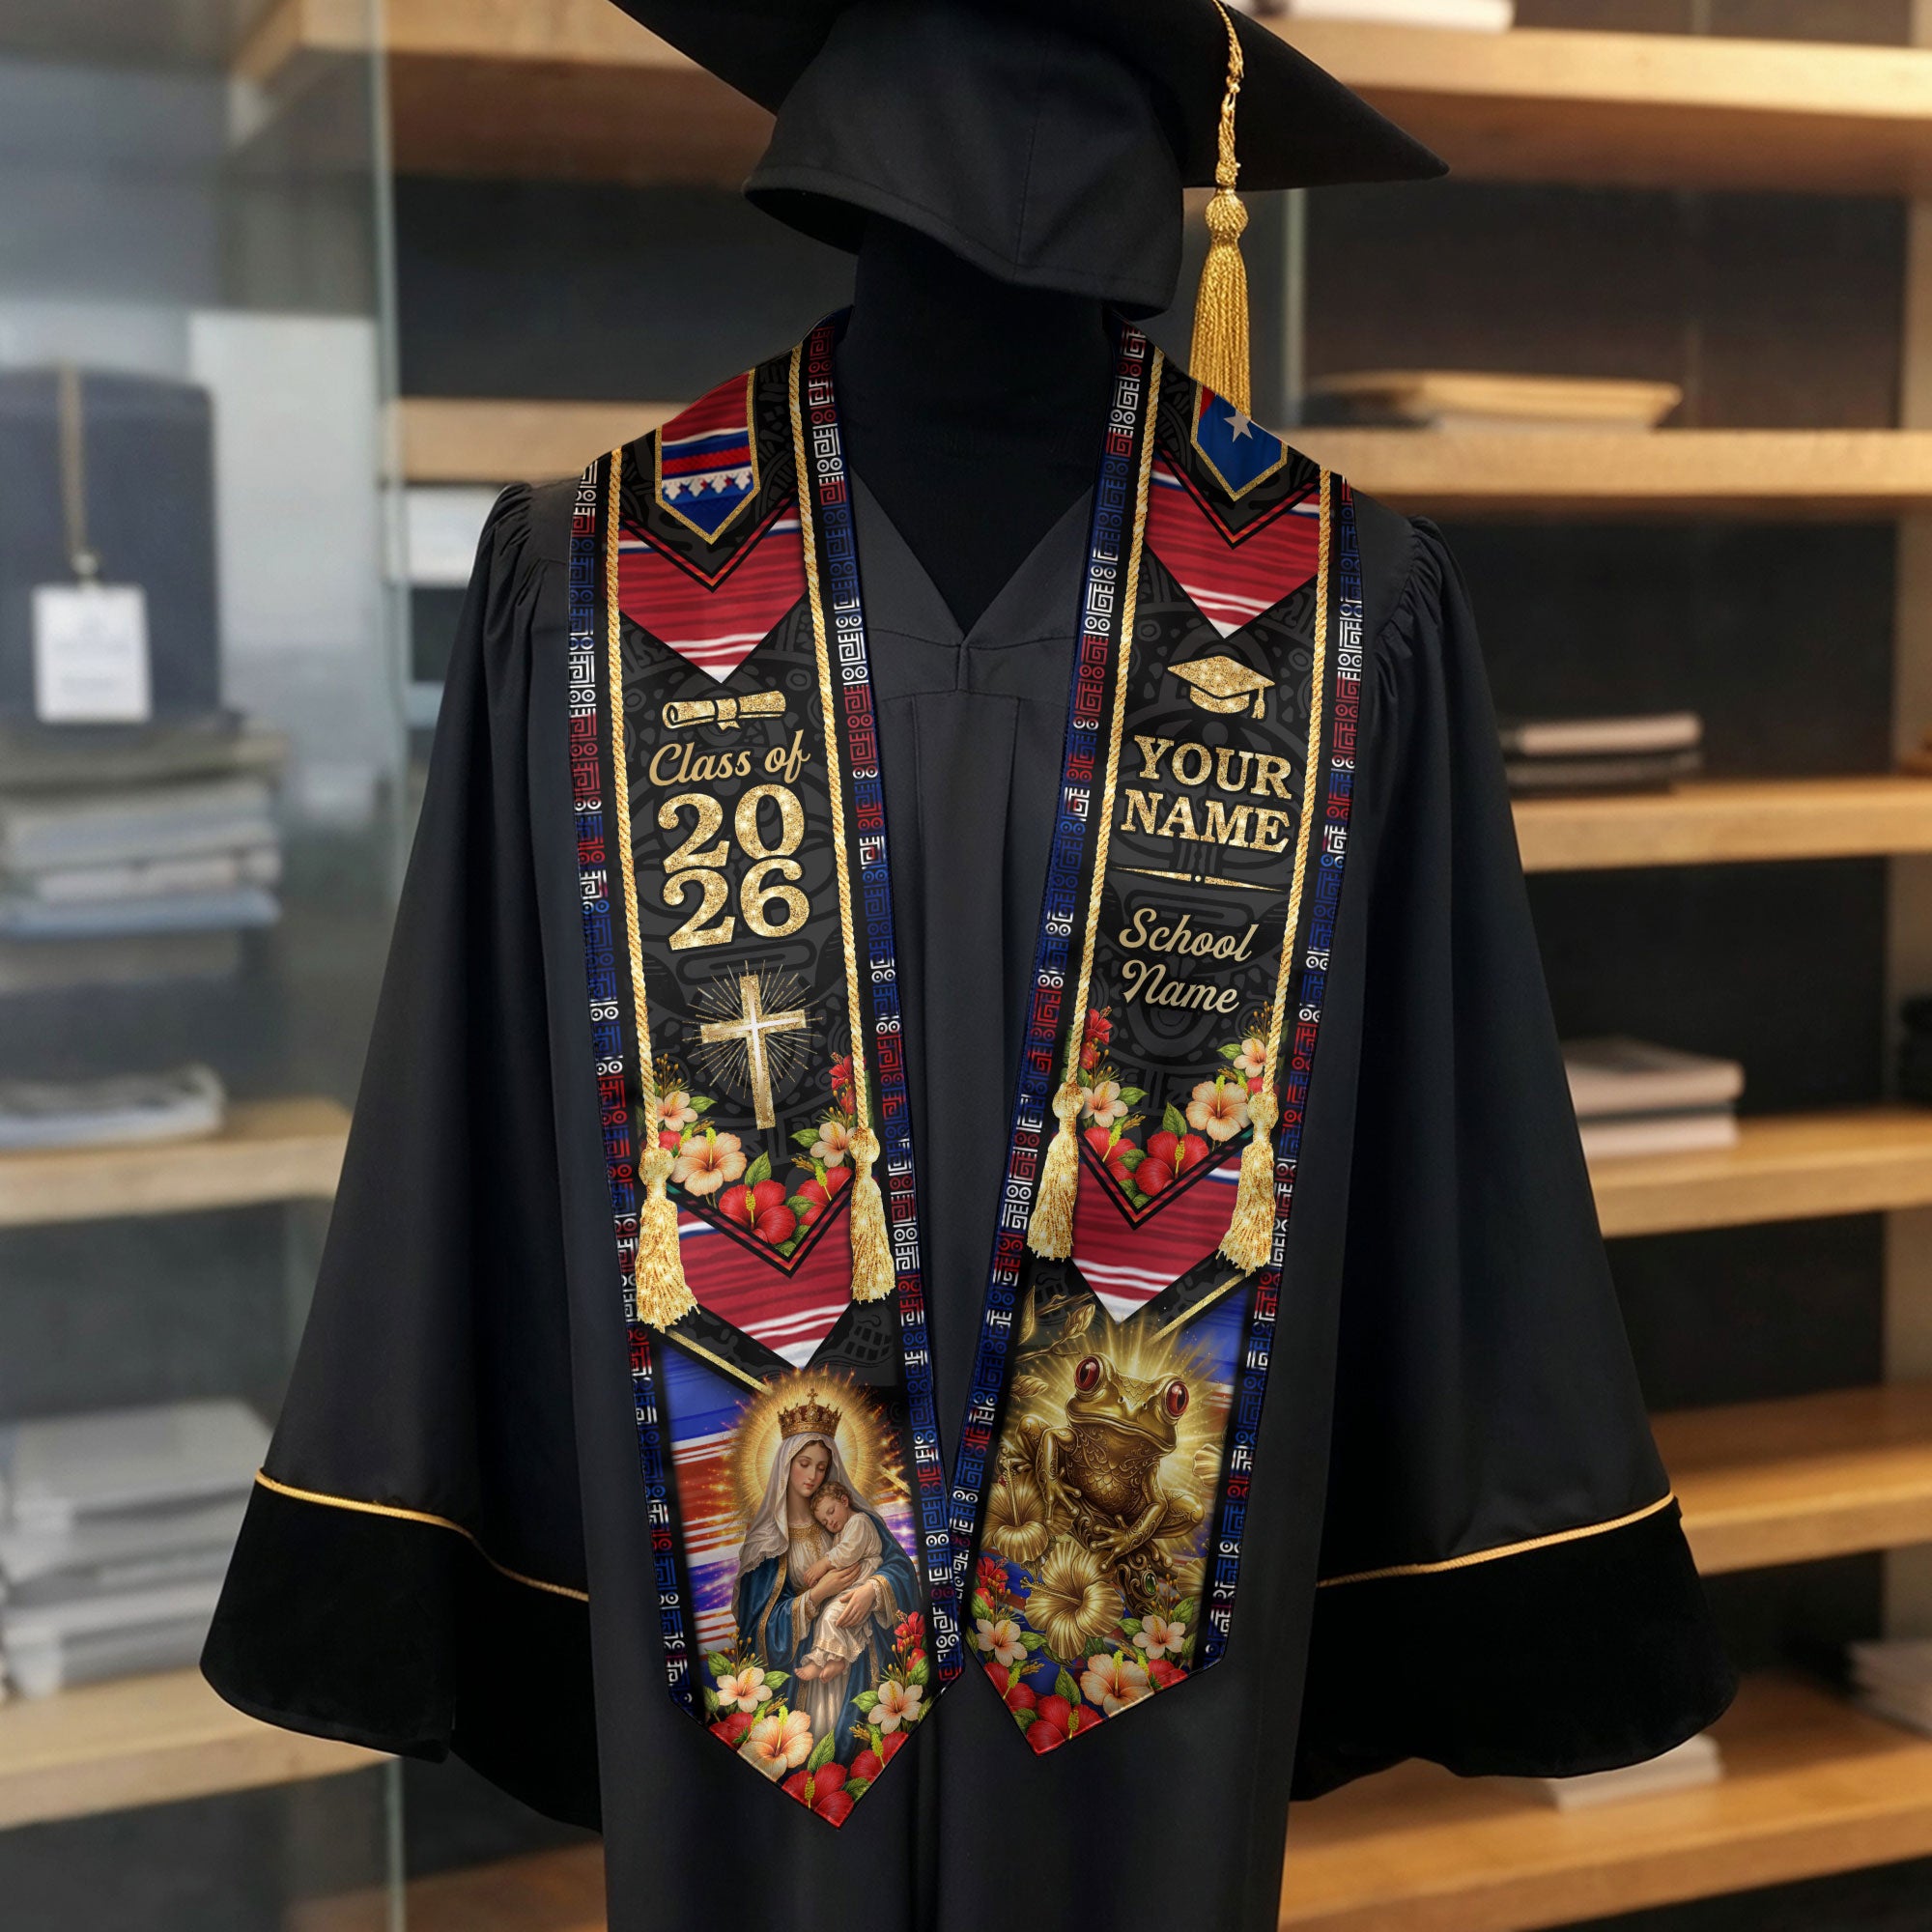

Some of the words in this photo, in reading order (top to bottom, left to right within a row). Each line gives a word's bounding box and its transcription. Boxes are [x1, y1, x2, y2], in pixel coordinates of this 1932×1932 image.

[649, 742, 752, 786] Class
[764, 729, 810, 783] of
[1134, 734, 1293, 800] YOUR
[658, 783, 805, 873] 20
[1121, 788, 1291, 853] NAME
[663, 858, 810, 951] 26
[1119, 907, 1259, 962] School
[1122, 959, 1239, 1013] Name
